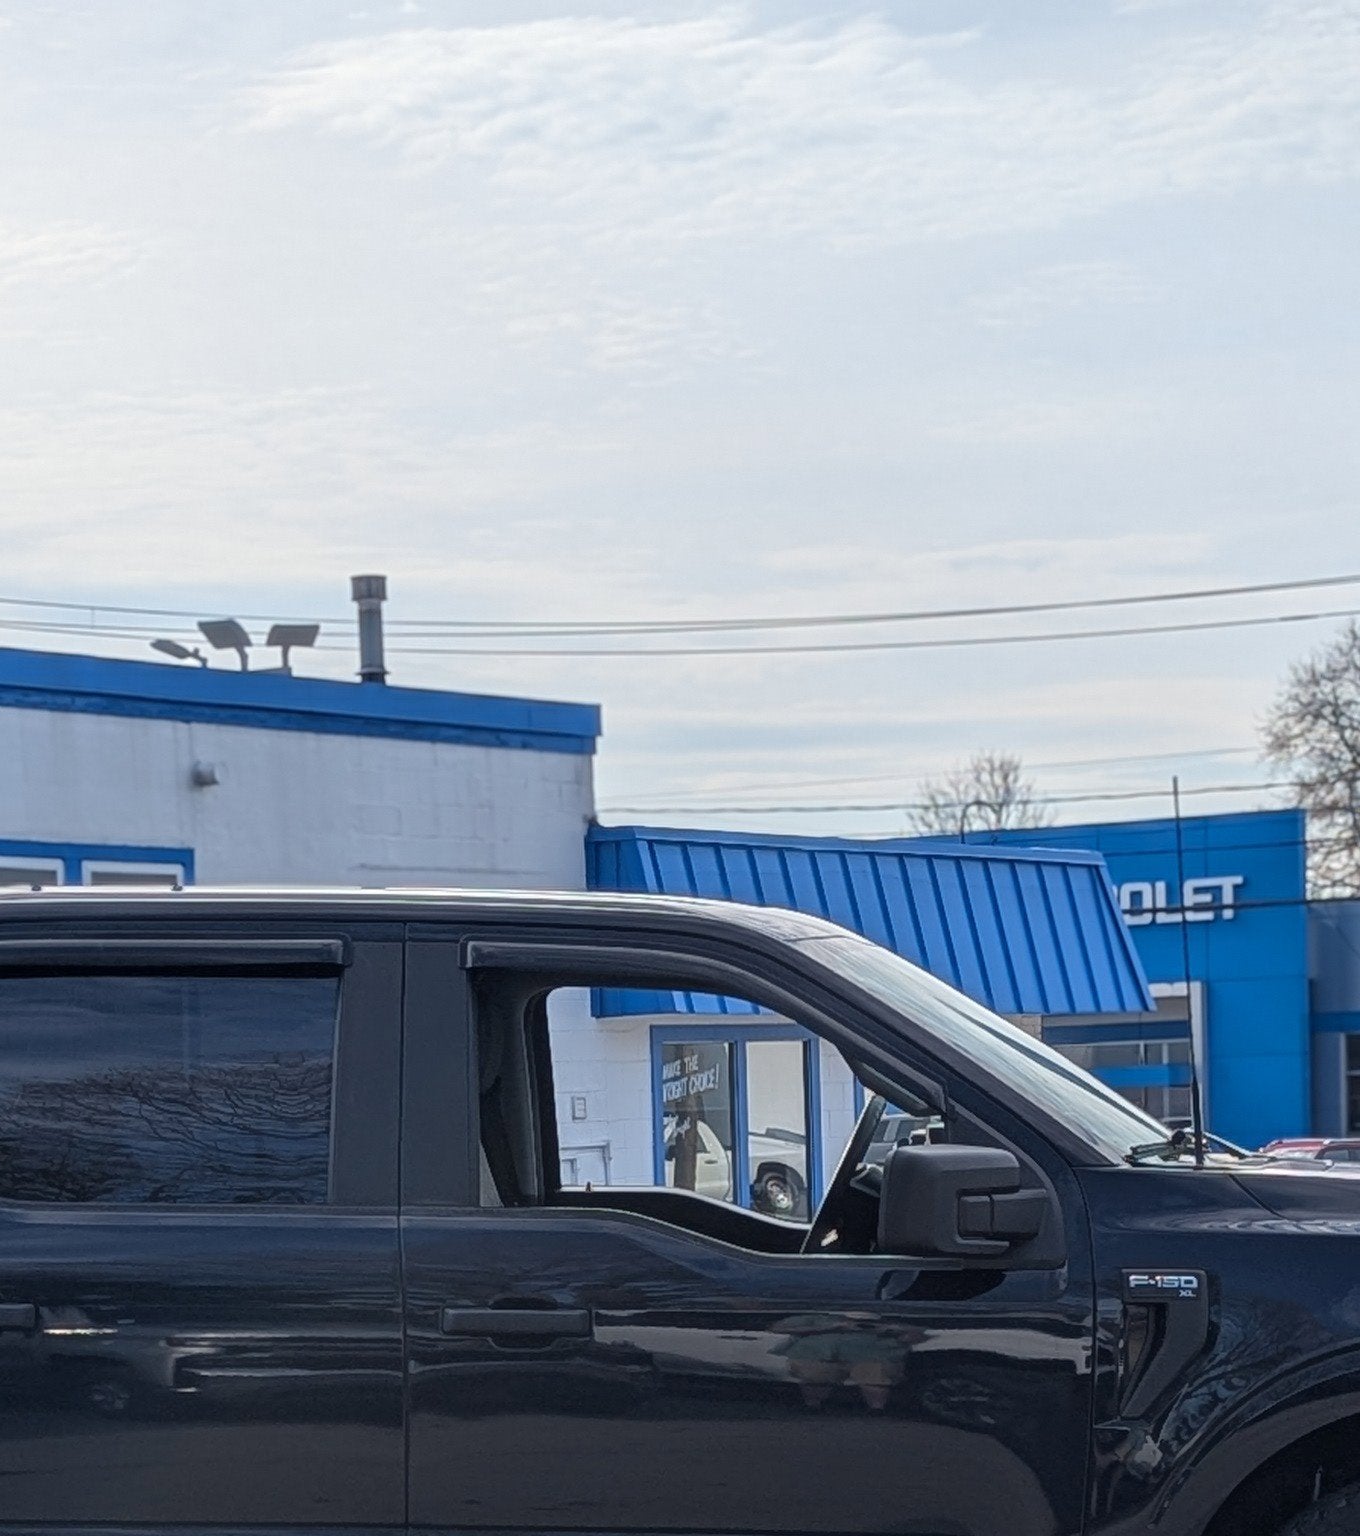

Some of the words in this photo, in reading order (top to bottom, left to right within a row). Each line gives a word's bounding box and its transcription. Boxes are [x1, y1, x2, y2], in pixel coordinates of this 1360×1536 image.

[1112, 876, 1244, 926] OLET
[684, 1054, 699, 1074] THE
[1129, 1275, 1198, 1288] F-150
